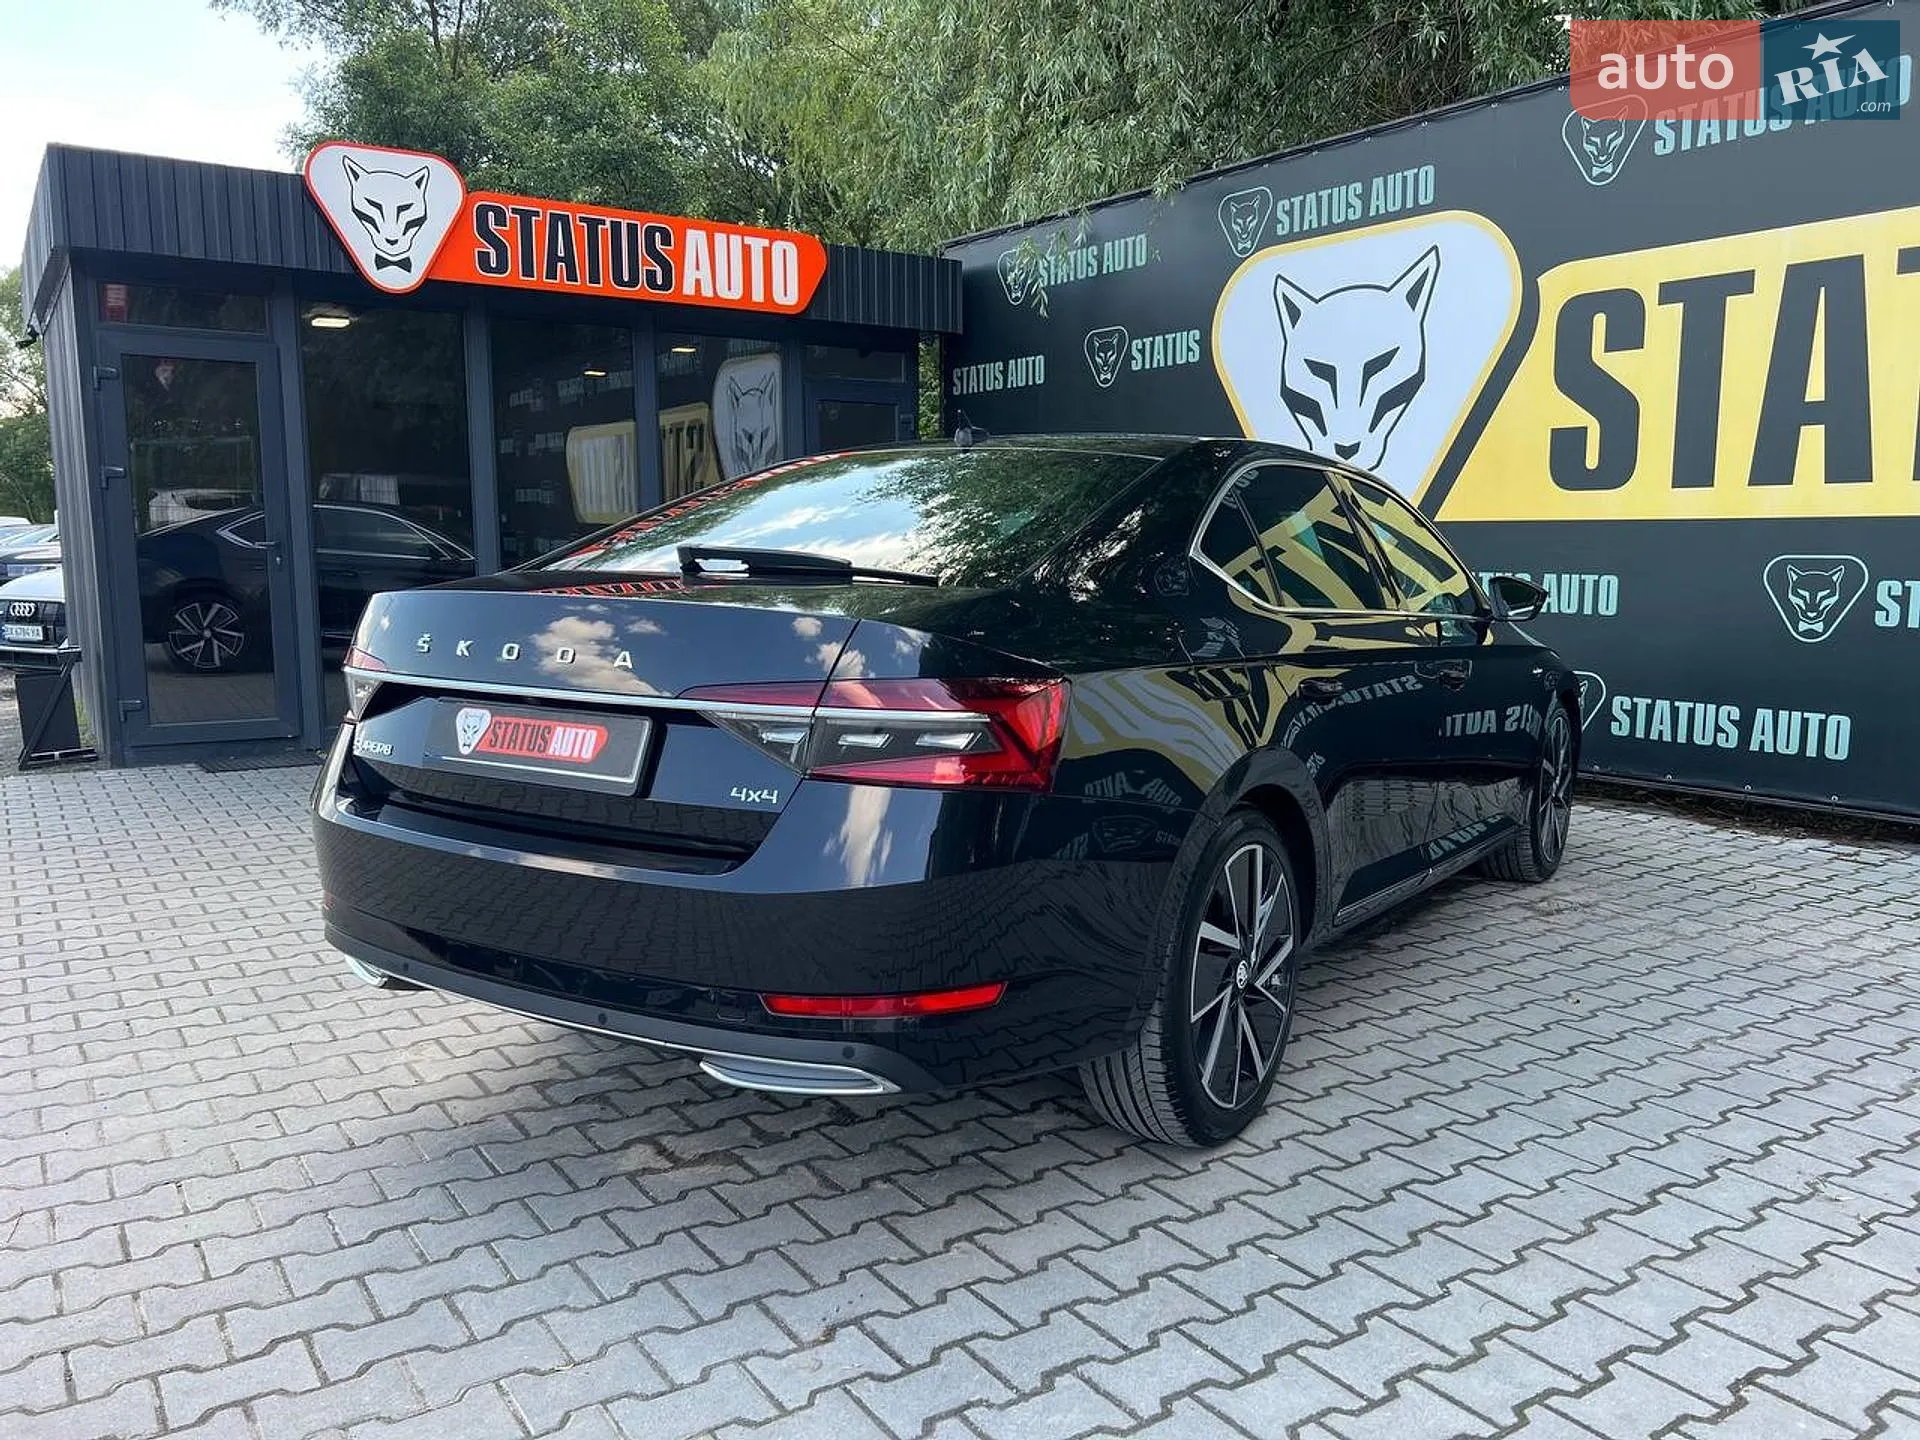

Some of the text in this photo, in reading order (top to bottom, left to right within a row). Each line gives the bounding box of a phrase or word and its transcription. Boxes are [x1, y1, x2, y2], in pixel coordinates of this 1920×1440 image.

[1654, 84, 1793, 156] STATUS
[1276, 165, 1435, 236] STATUS AUTO
[474, 201, 799, 306] STATUS AUTO
[1039, 233, 1148, 287] STATUS AUTO
[952, 354, 1045, 395] STATUS AUTO
[1131, 330, 1200, 371] STATUS
[1541, 572, 1619, 616] AUTO
[416, 632, 635, 669] ŠKODA
[490, 721, 597, 759] STATUS AUTO
[1610, 695, 1852, 761] STATUS AUTO
